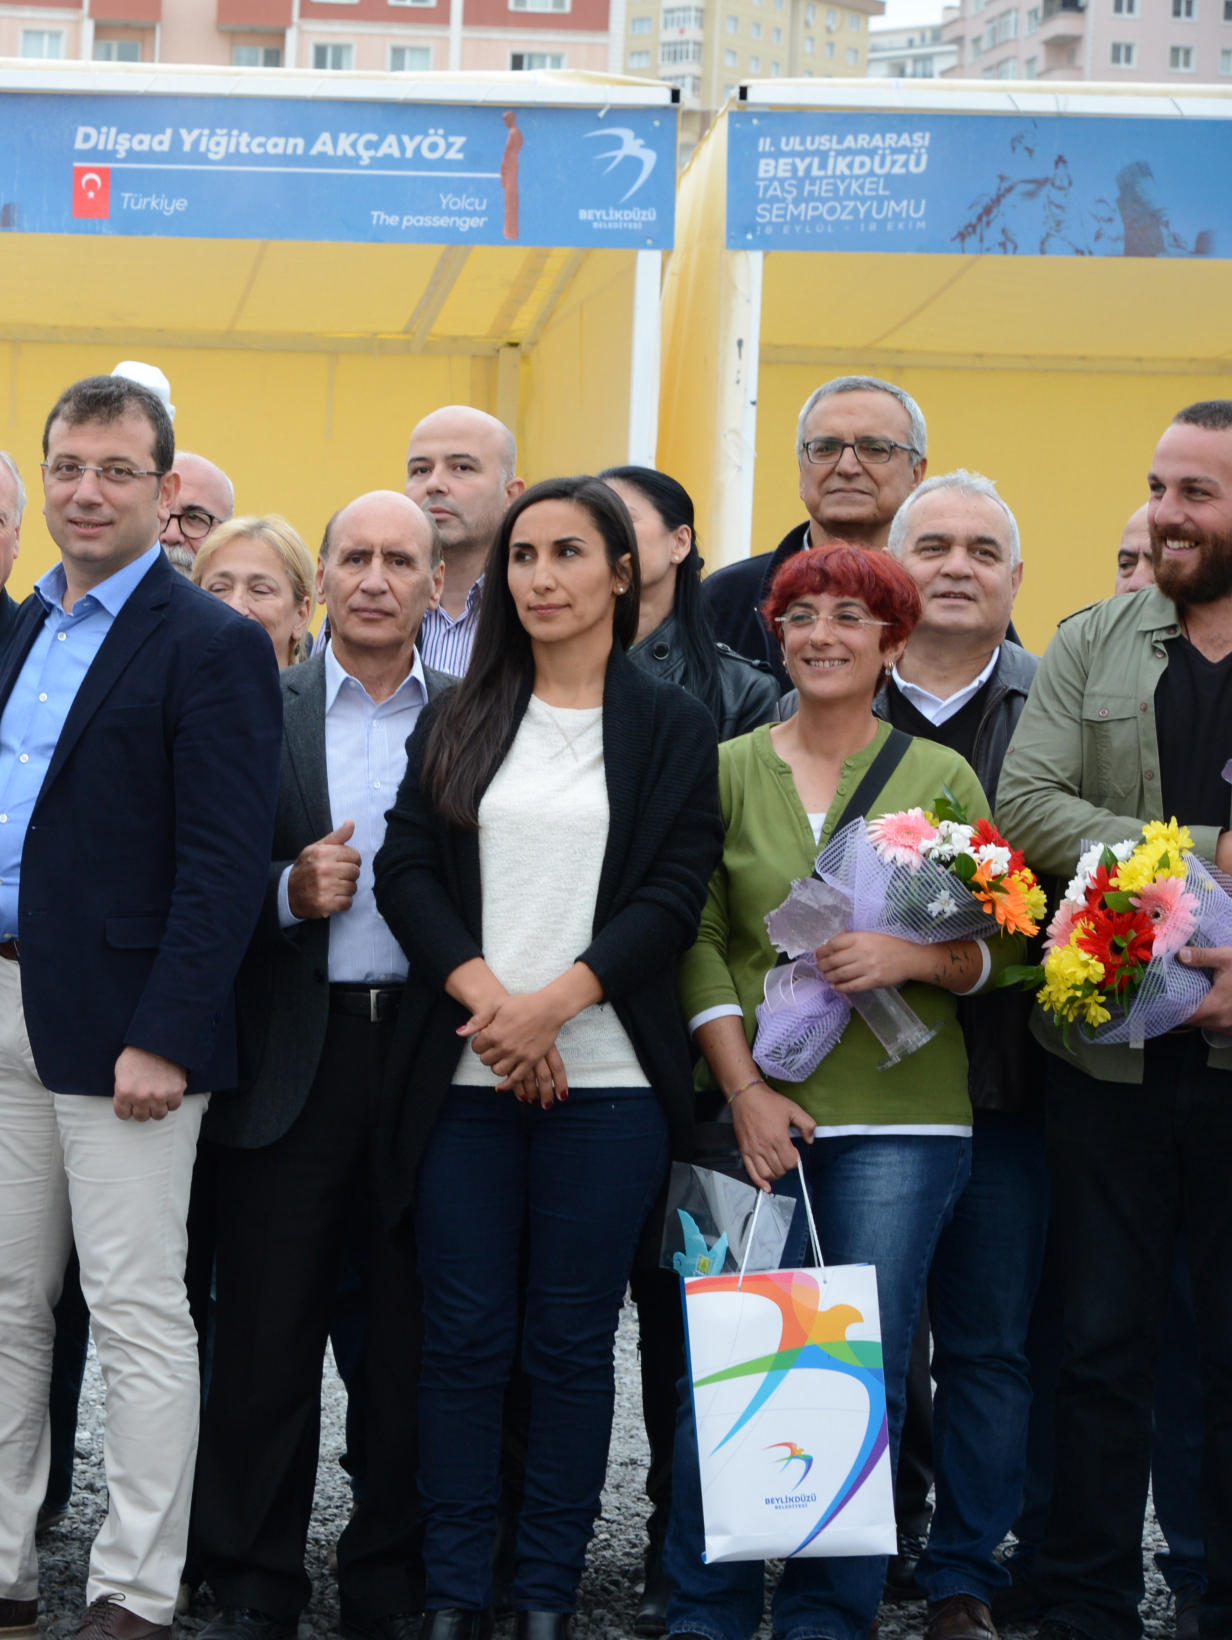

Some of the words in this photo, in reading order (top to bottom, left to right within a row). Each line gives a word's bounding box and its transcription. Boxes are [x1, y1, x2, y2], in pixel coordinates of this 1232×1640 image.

[74, 126, 173, 158] Dilşad
[179, 128, 305, 160] Yiğitcan
[309, 128, 467, 165] AKÇAYÖZ
[758, 137, 774, 152] II.
[781, 132, 930, 151] ULUSLARARASI
[758, 148, 928, 178] BEYLİKDÜZÜ
[755, 179, 797, 202] TAŞ
[804, 177, 890, 197] HEYKEL
[120, 193, 188, 215] Türkiye
[440, 193, 487, 210] Yolcu
[755, 199, 926, 222] SEMPOZYUMU
[370, 211, 399, 225] The
[402, 215, 487, 231] passenger
[579, 207, 656, 221] BEYLİKDÜZÜ
